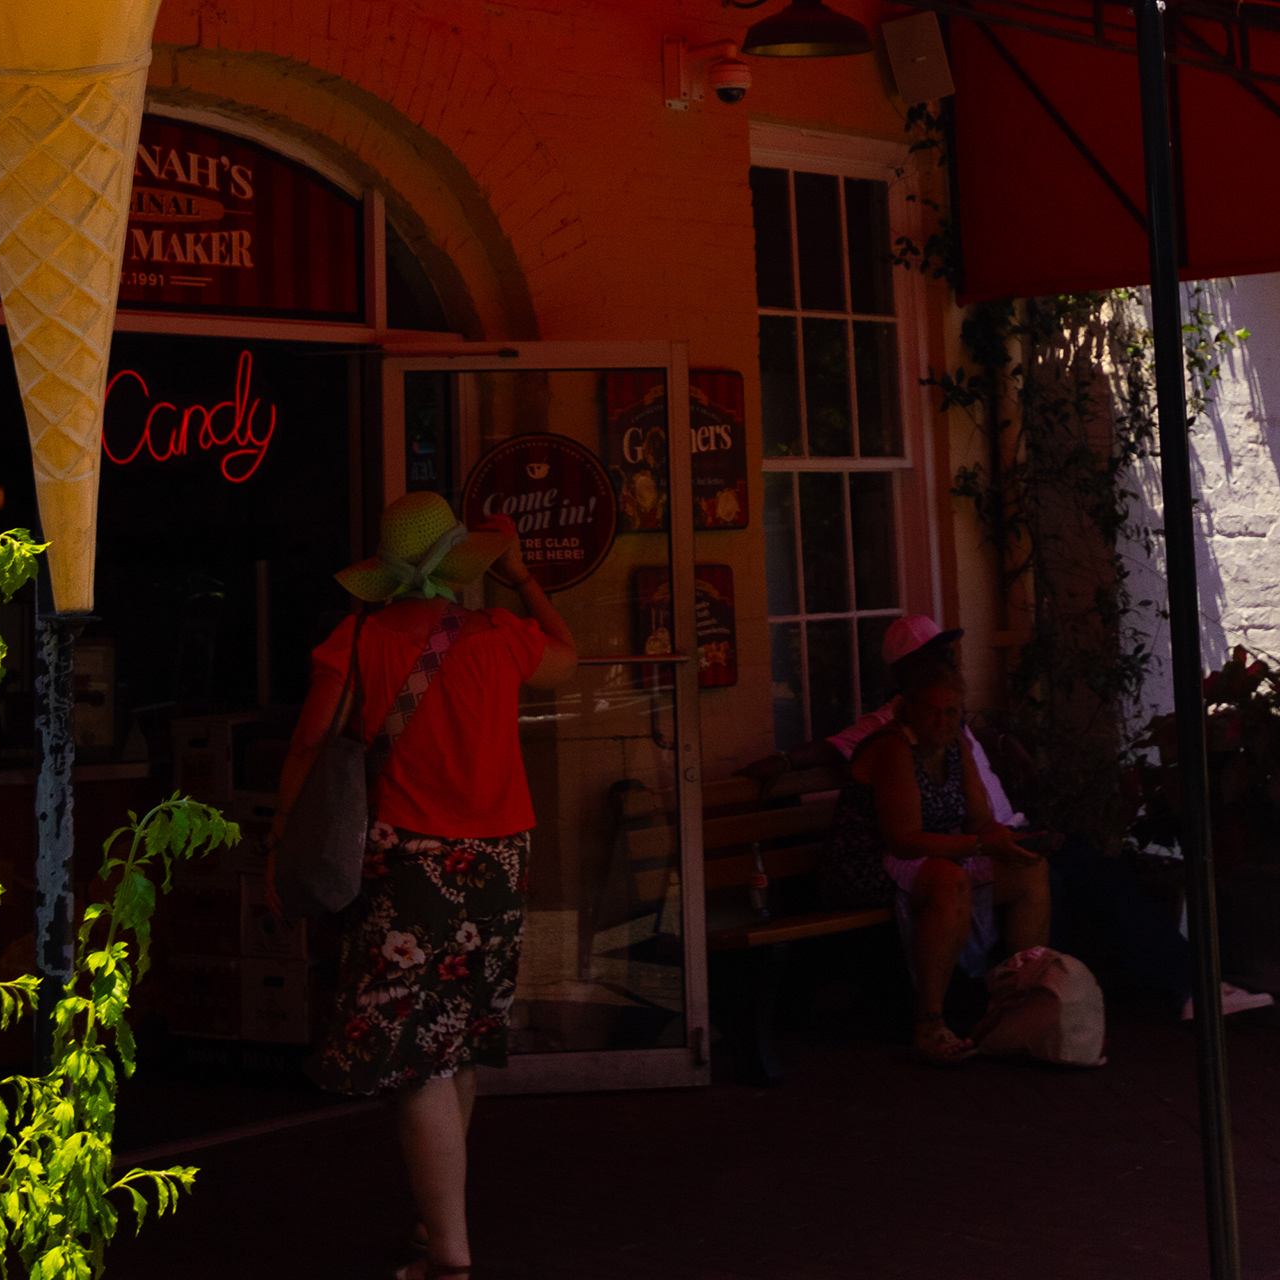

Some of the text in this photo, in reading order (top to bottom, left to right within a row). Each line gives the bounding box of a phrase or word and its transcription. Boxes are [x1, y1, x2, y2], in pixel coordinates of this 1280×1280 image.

[130, 228, 255, 268] MAKER
[102, 351, 276, 482] Candy
[482, 488, 558, 516] Come
[518, 496, 598, 533] on in!
[545, 537, 580, 548] GLAD
[546, 549, 585, 560] HERE!
